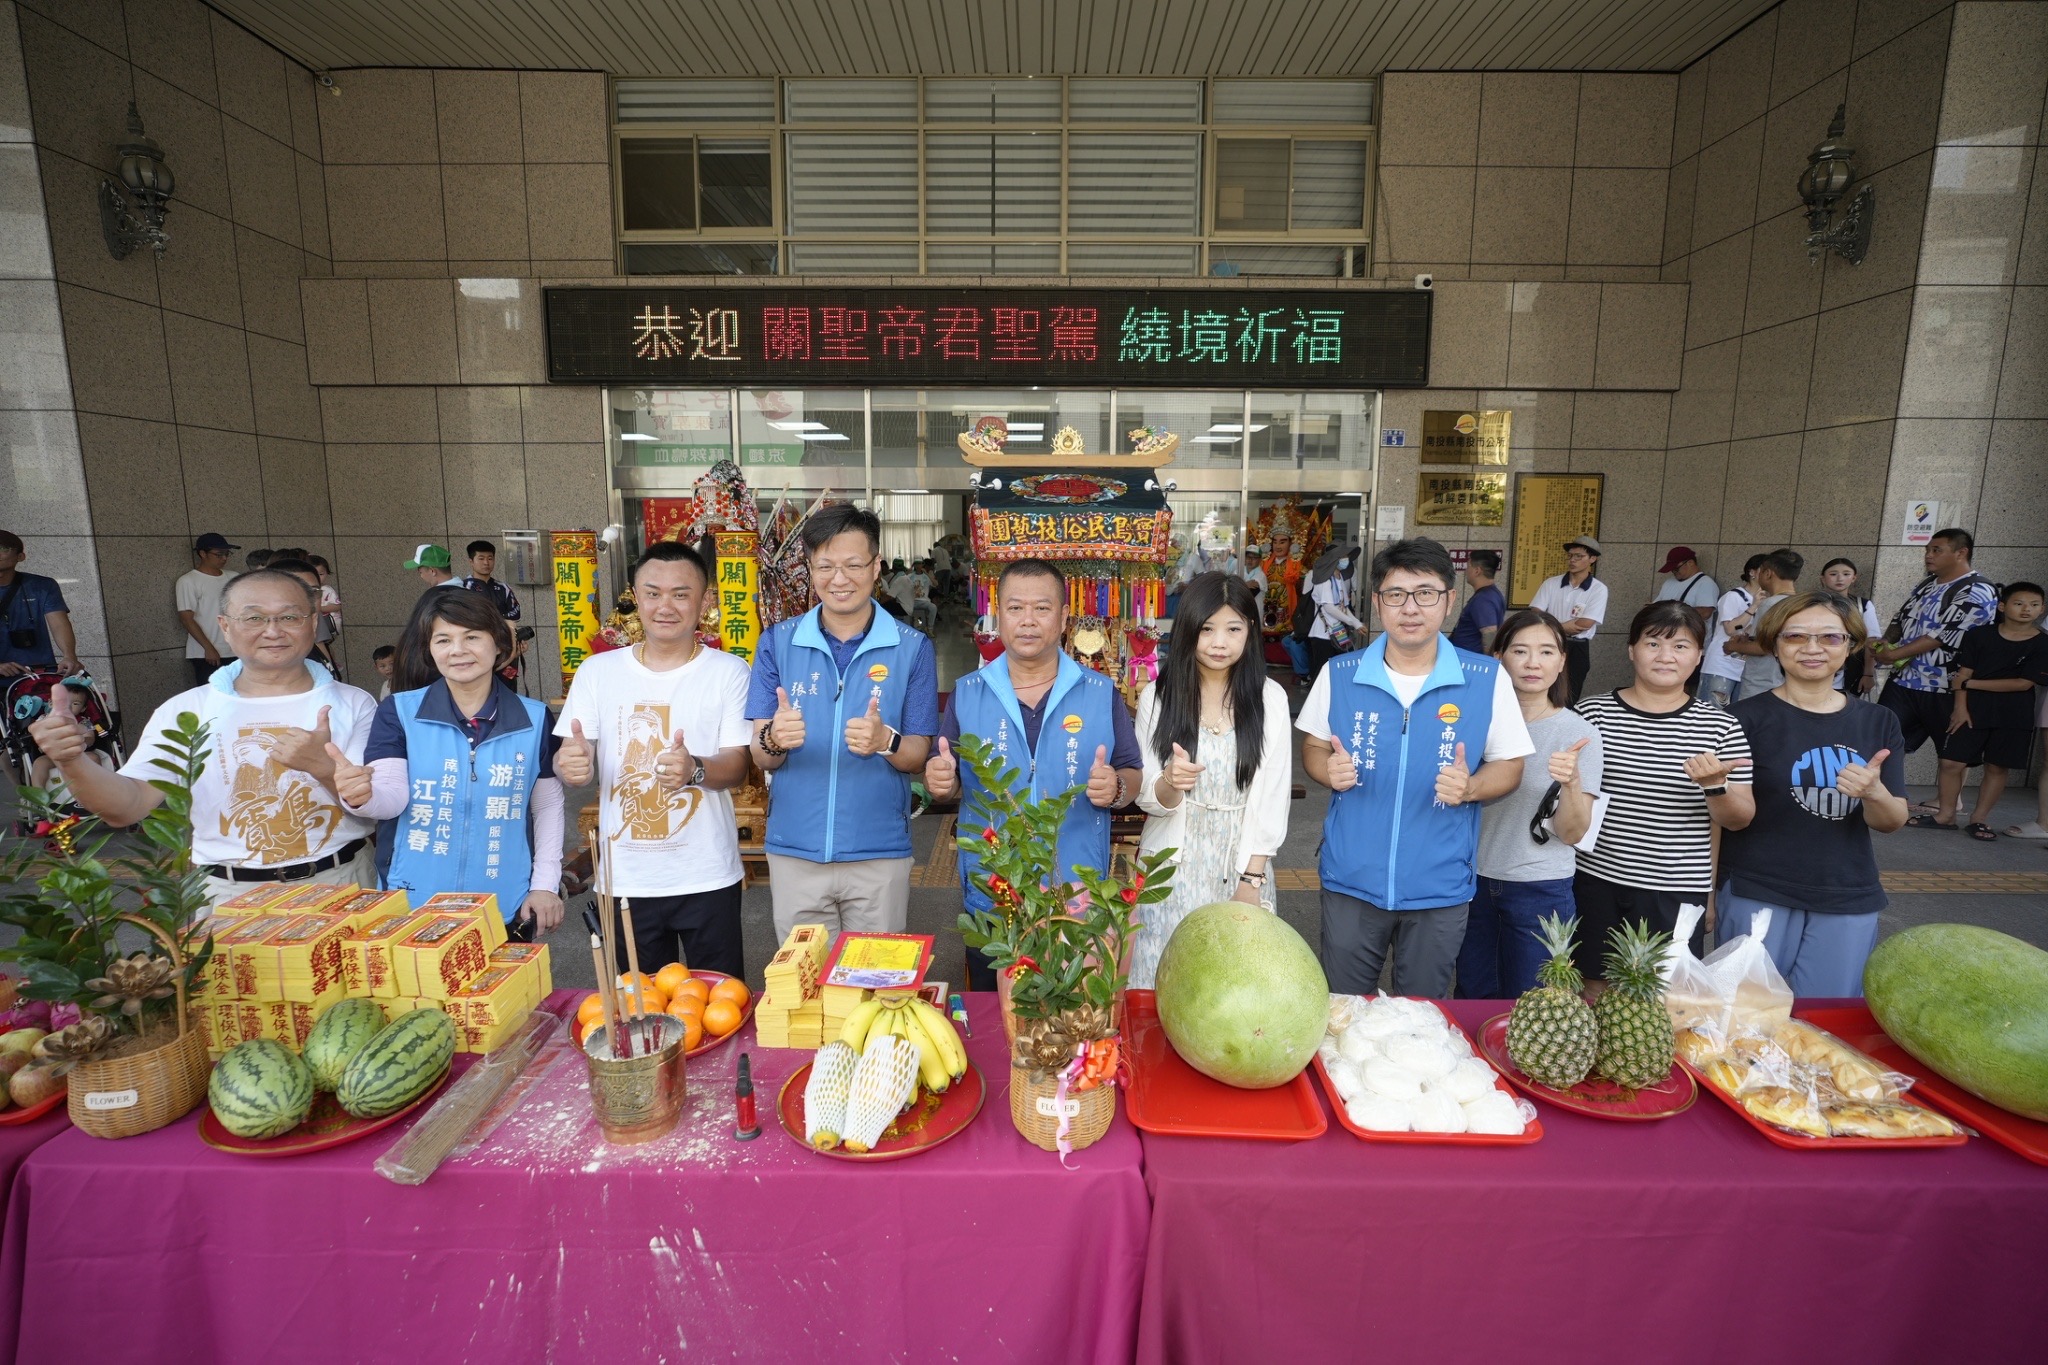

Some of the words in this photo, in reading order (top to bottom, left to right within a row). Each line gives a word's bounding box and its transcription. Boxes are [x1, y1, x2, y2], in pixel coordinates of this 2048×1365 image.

[632, 305, 742, 363] 恭迎
[761, 305, 1099, 363] 關聖帝君聖駕
[1118, 305, 1345, 364] 繞境祈福
[1391, 435, 1398, 445] 5
[1425, 437, 1506, 448] 南投縣南投市公所
[1429, 479, 1498, 491] 南投縣南投市
[556, 562, 587, 669] 關聖帝君
[808, 671, 820, 695] 市長
[1365, 712, 1380, 770] 觀光文化課
[432, 758, 458, 856] 南投市民代表
[510, 765, 525, 820] 立法委員
[407, 778, 437, 853] 江秀春
[485, 826, 501, 880] 服務團隊
[211, 953, 232, 996] 環保金
[342, 947, 363, 990] 環保金
[218, 1004, 239, 1048] 環保金
[270, 1003, 292, 1045] 環保金
[90, 1095, 131, 1105] FLOWER
[1041, 1102, 1075, 1112] FLOER
